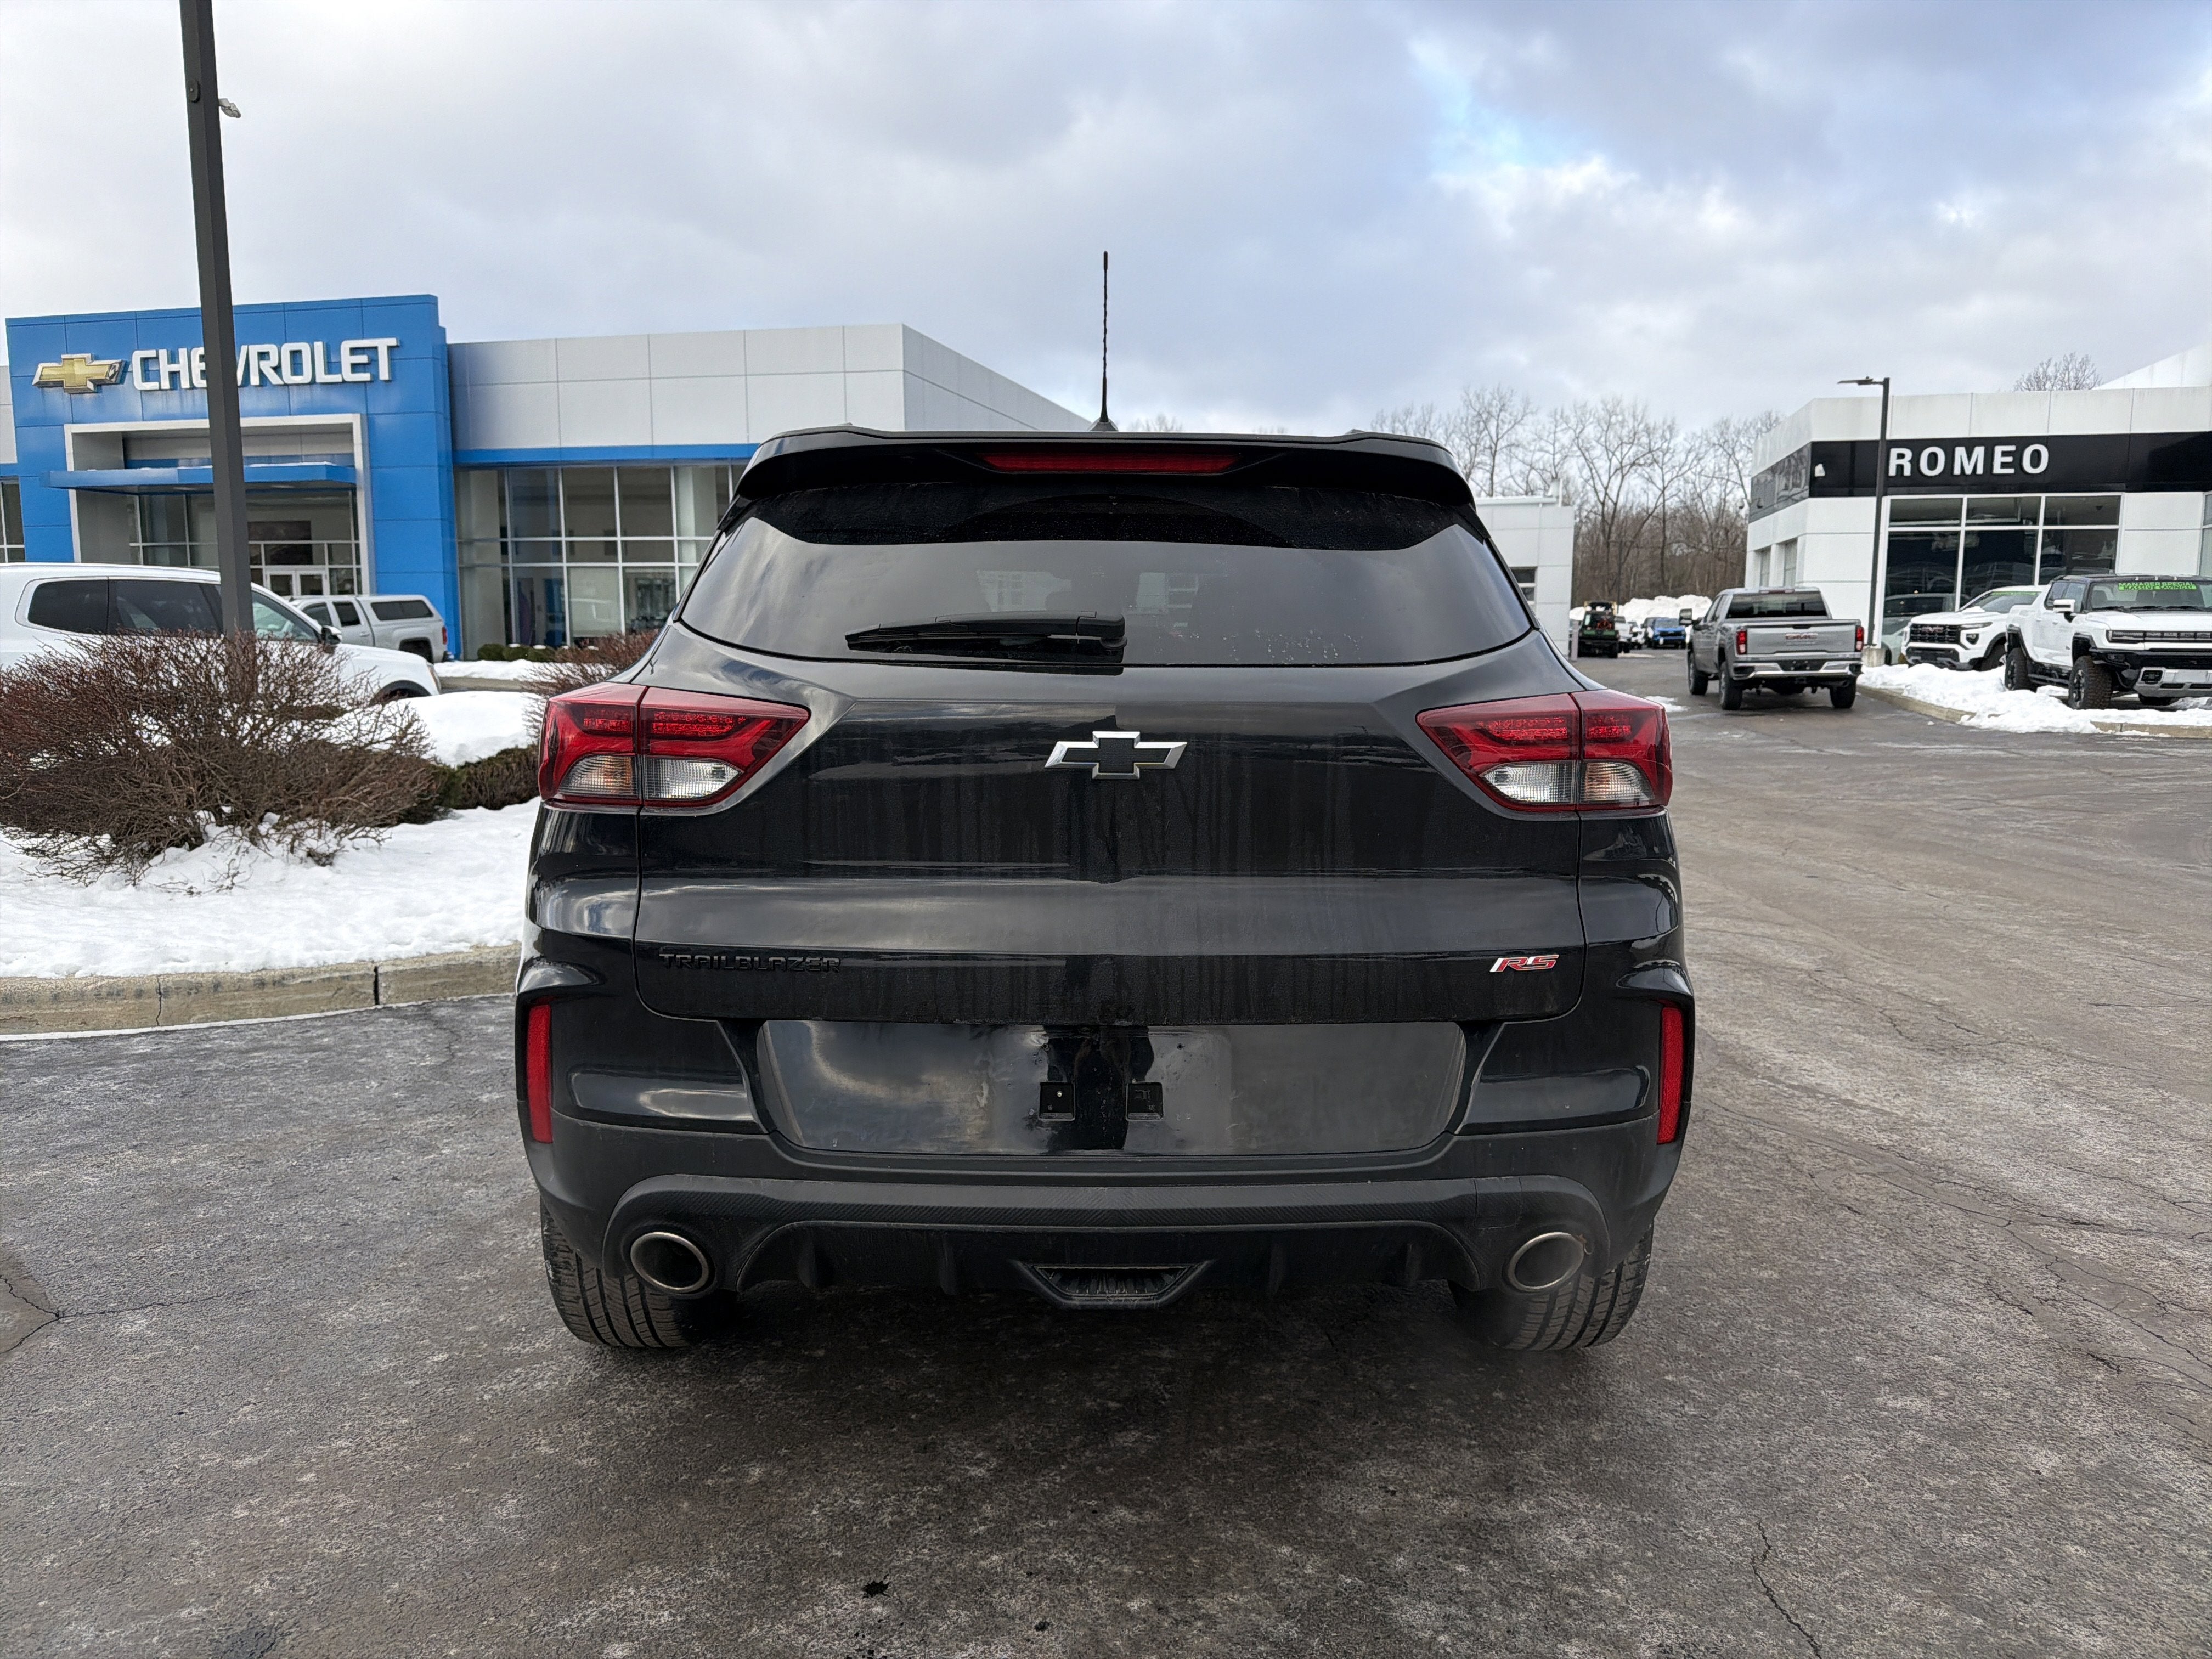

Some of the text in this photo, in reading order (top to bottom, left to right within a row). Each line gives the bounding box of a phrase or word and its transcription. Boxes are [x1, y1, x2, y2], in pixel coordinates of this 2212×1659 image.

[1888, 444, 2049, 476] ROMEO
[659, 953, 840, 972] TRAILBLAZER
[1489, 955, 1559, 973] RS
